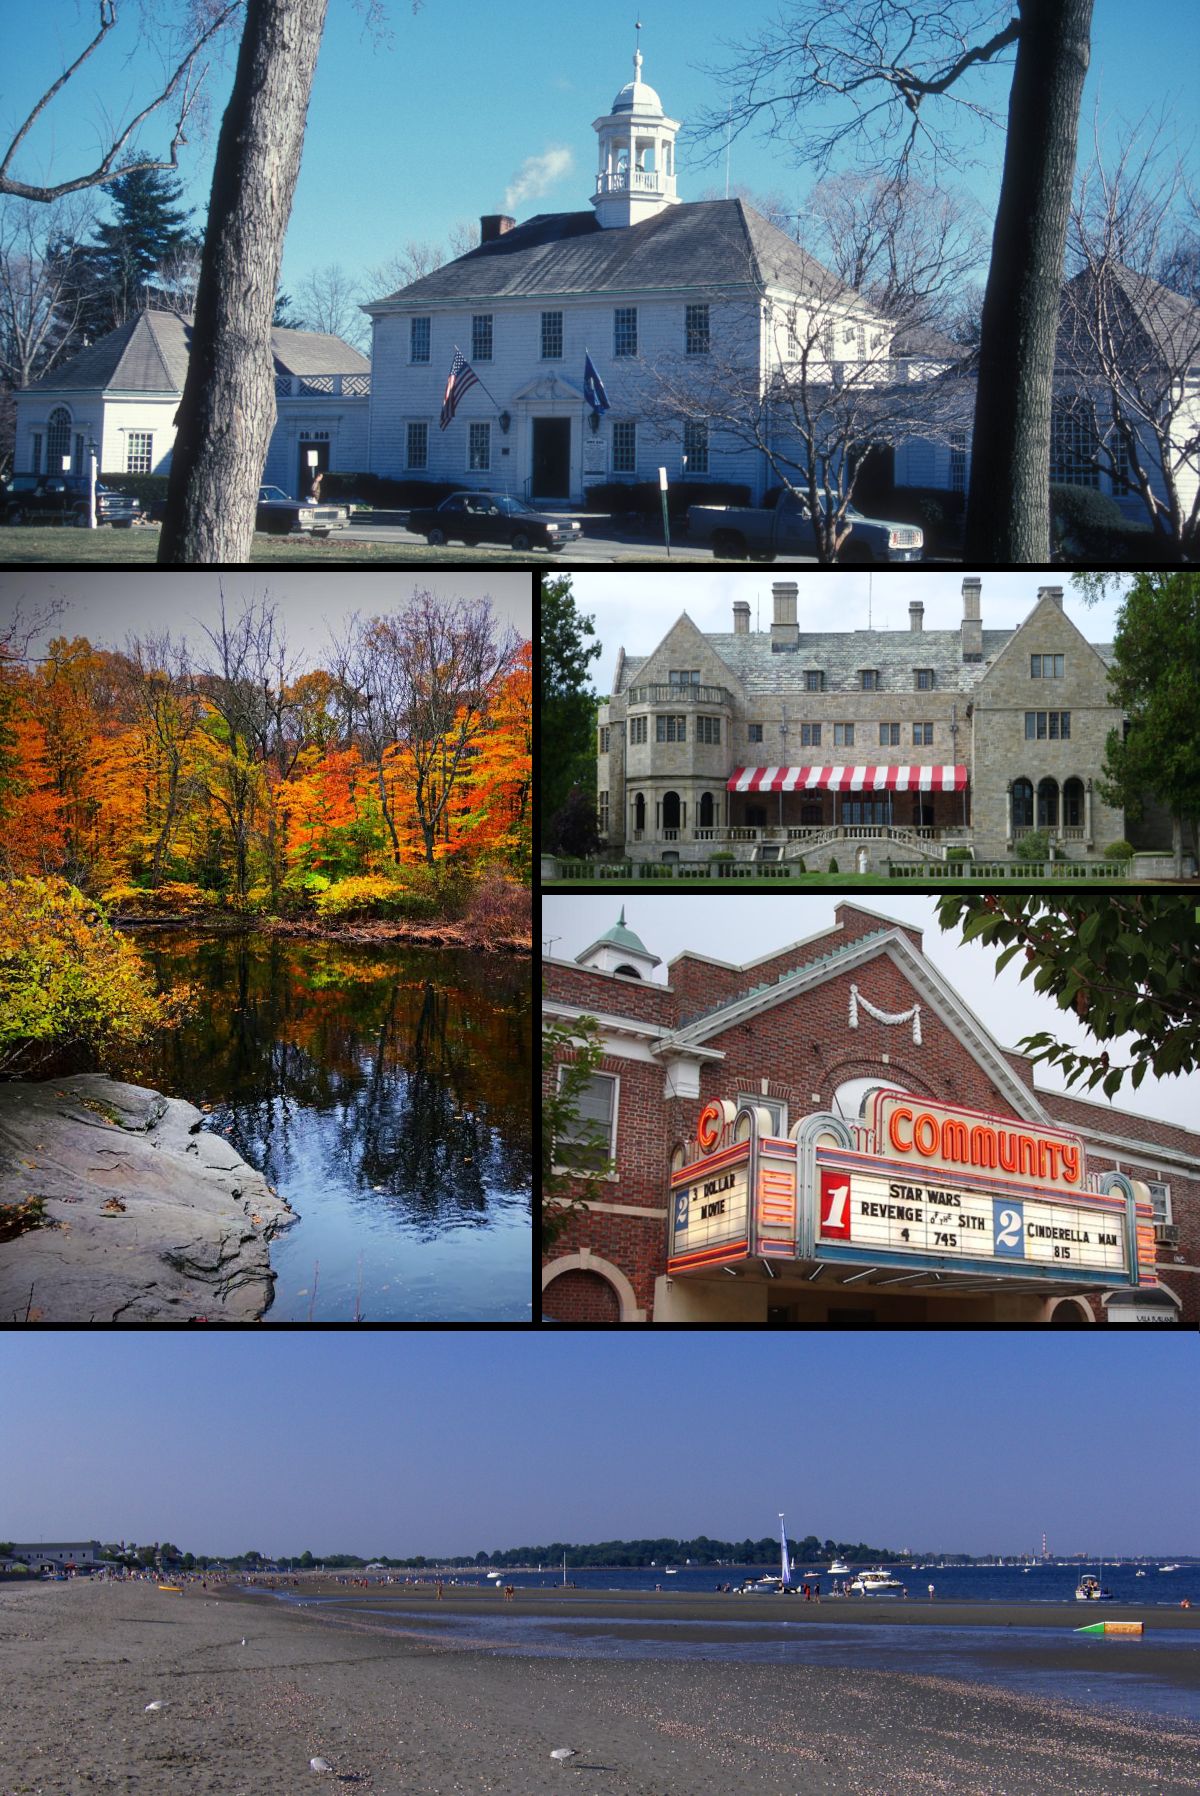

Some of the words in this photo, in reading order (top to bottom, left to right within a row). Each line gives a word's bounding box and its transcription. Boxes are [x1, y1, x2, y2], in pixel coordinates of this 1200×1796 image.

[889, 1107, 1080, 1184] COMMUNITY
[692, 1187, 698, 1201] 3
[704, 1174, 735, 1198] DOLLAR
[890, 1184, 922, 1201] STAR
[928, 1190, 961, 1207] WARS
[676, 1196, 688, 1224] 2
[701, 1199, 725, 1219] MOVIE
[822, 1185, 848, 1228] 1
[861, 1201, 923, 1222] REVENGE
[930, 1211, 939, 1224] OF
[958, 1214, 985, 1230] SITH
[901, 1228, 910, 1242] 4
[934, 1232, 957, 1247] 745
[996, 1210, 1022, 1247] 2
[1027, 1222, 1090, 1243] CINDERELLA
[1098, 1233, 1117, 1246] MAN
[1054, 1246, 1071, 1259] 815
